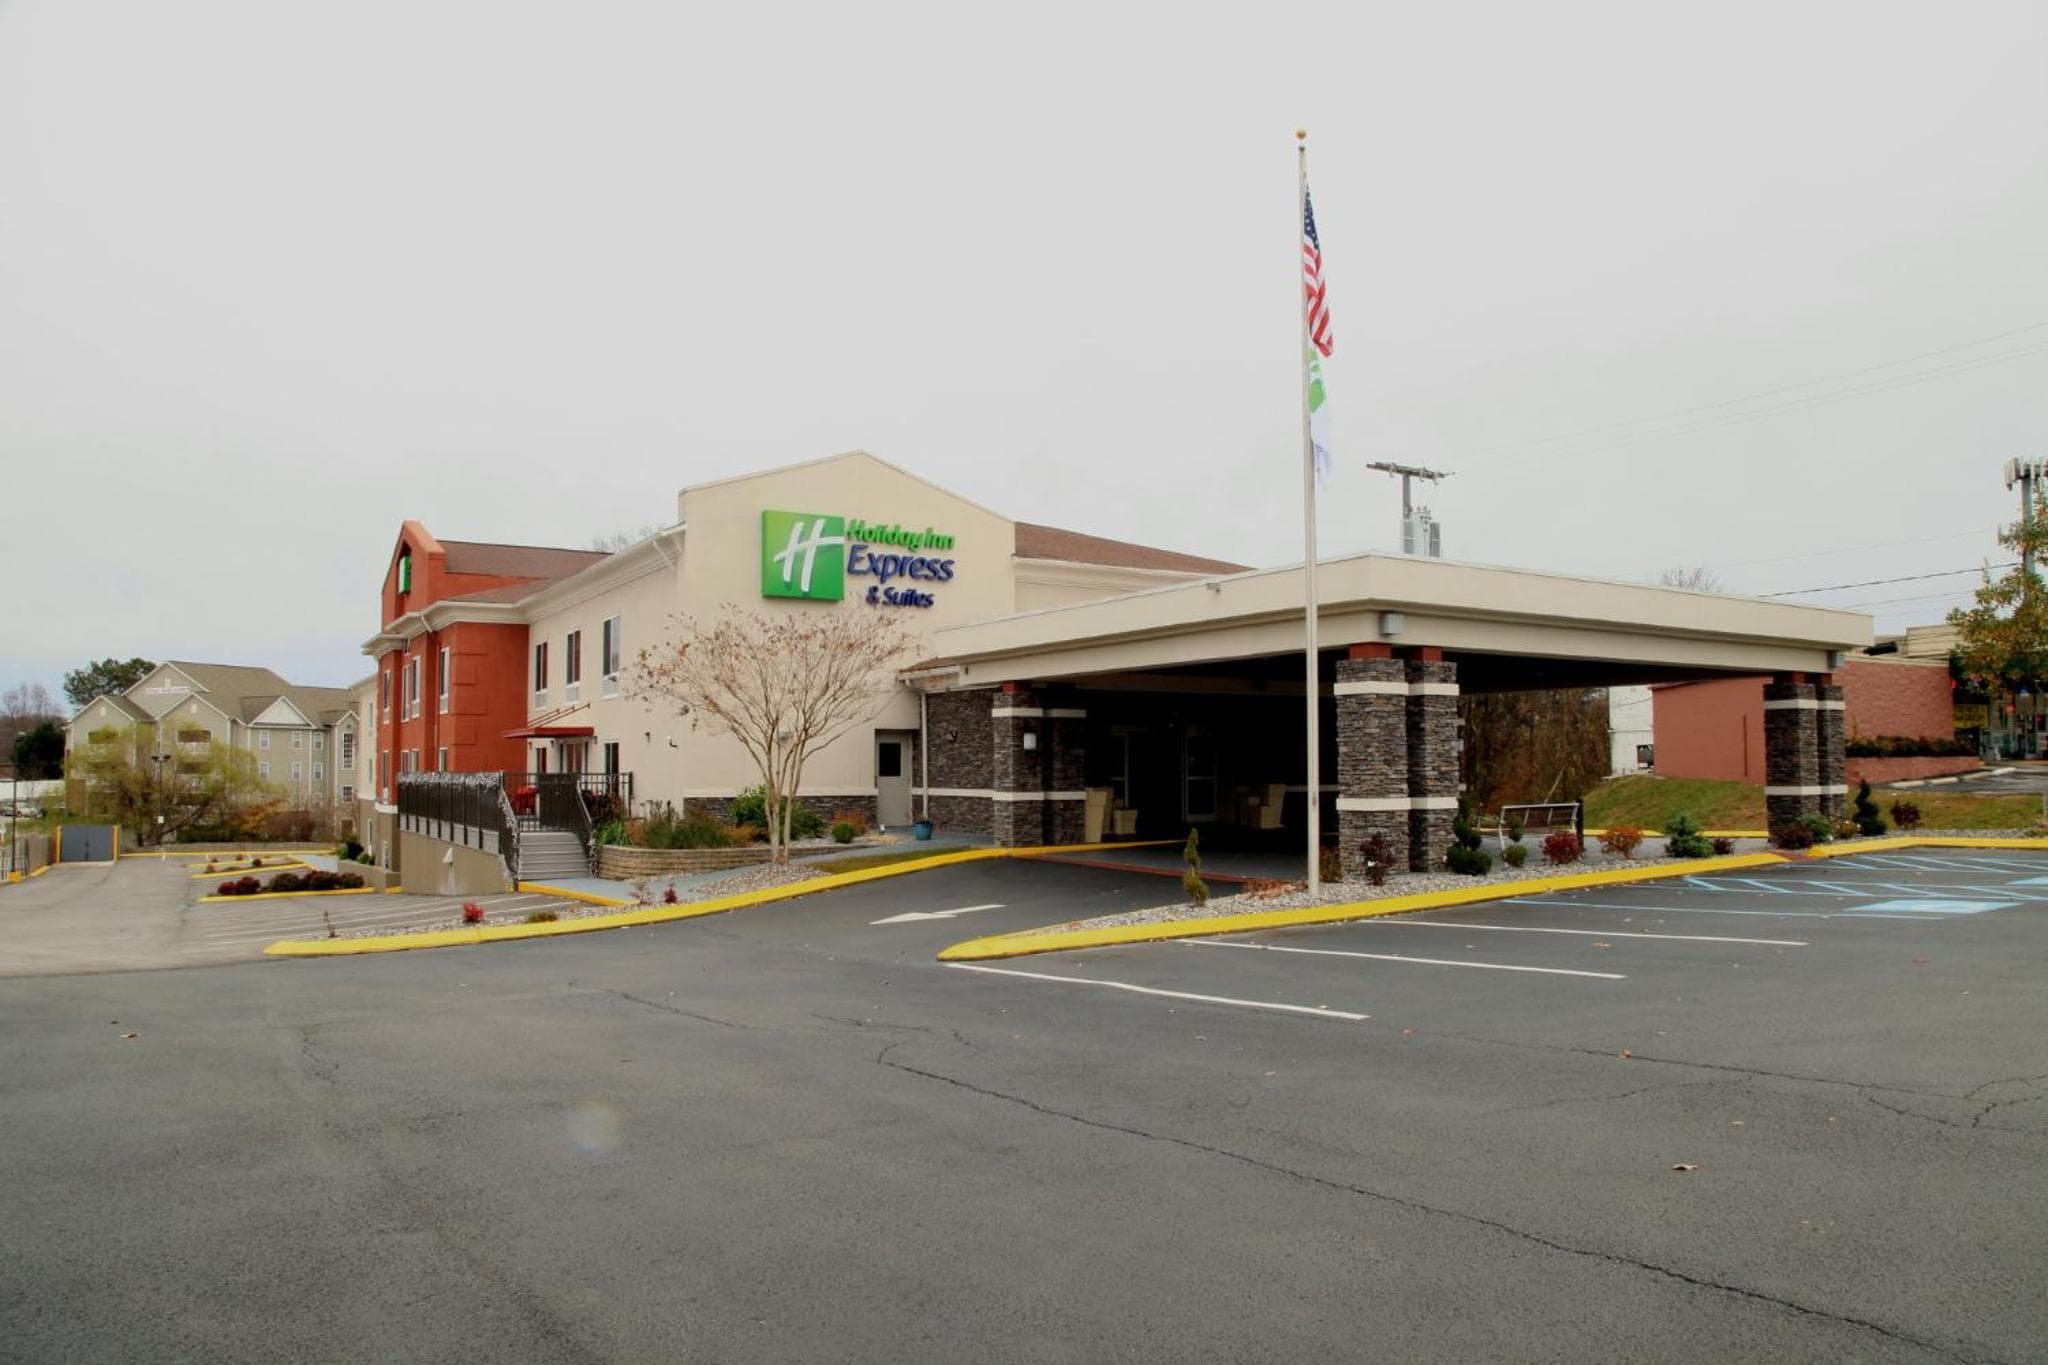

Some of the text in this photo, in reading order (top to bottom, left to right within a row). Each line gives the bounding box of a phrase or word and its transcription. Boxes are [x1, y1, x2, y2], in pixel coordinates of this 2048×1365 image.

[847, 519, 955, 552] Holiday Inn
[847, 544, 955, 585] Express
[865, 585, 934, 608] & Suites
